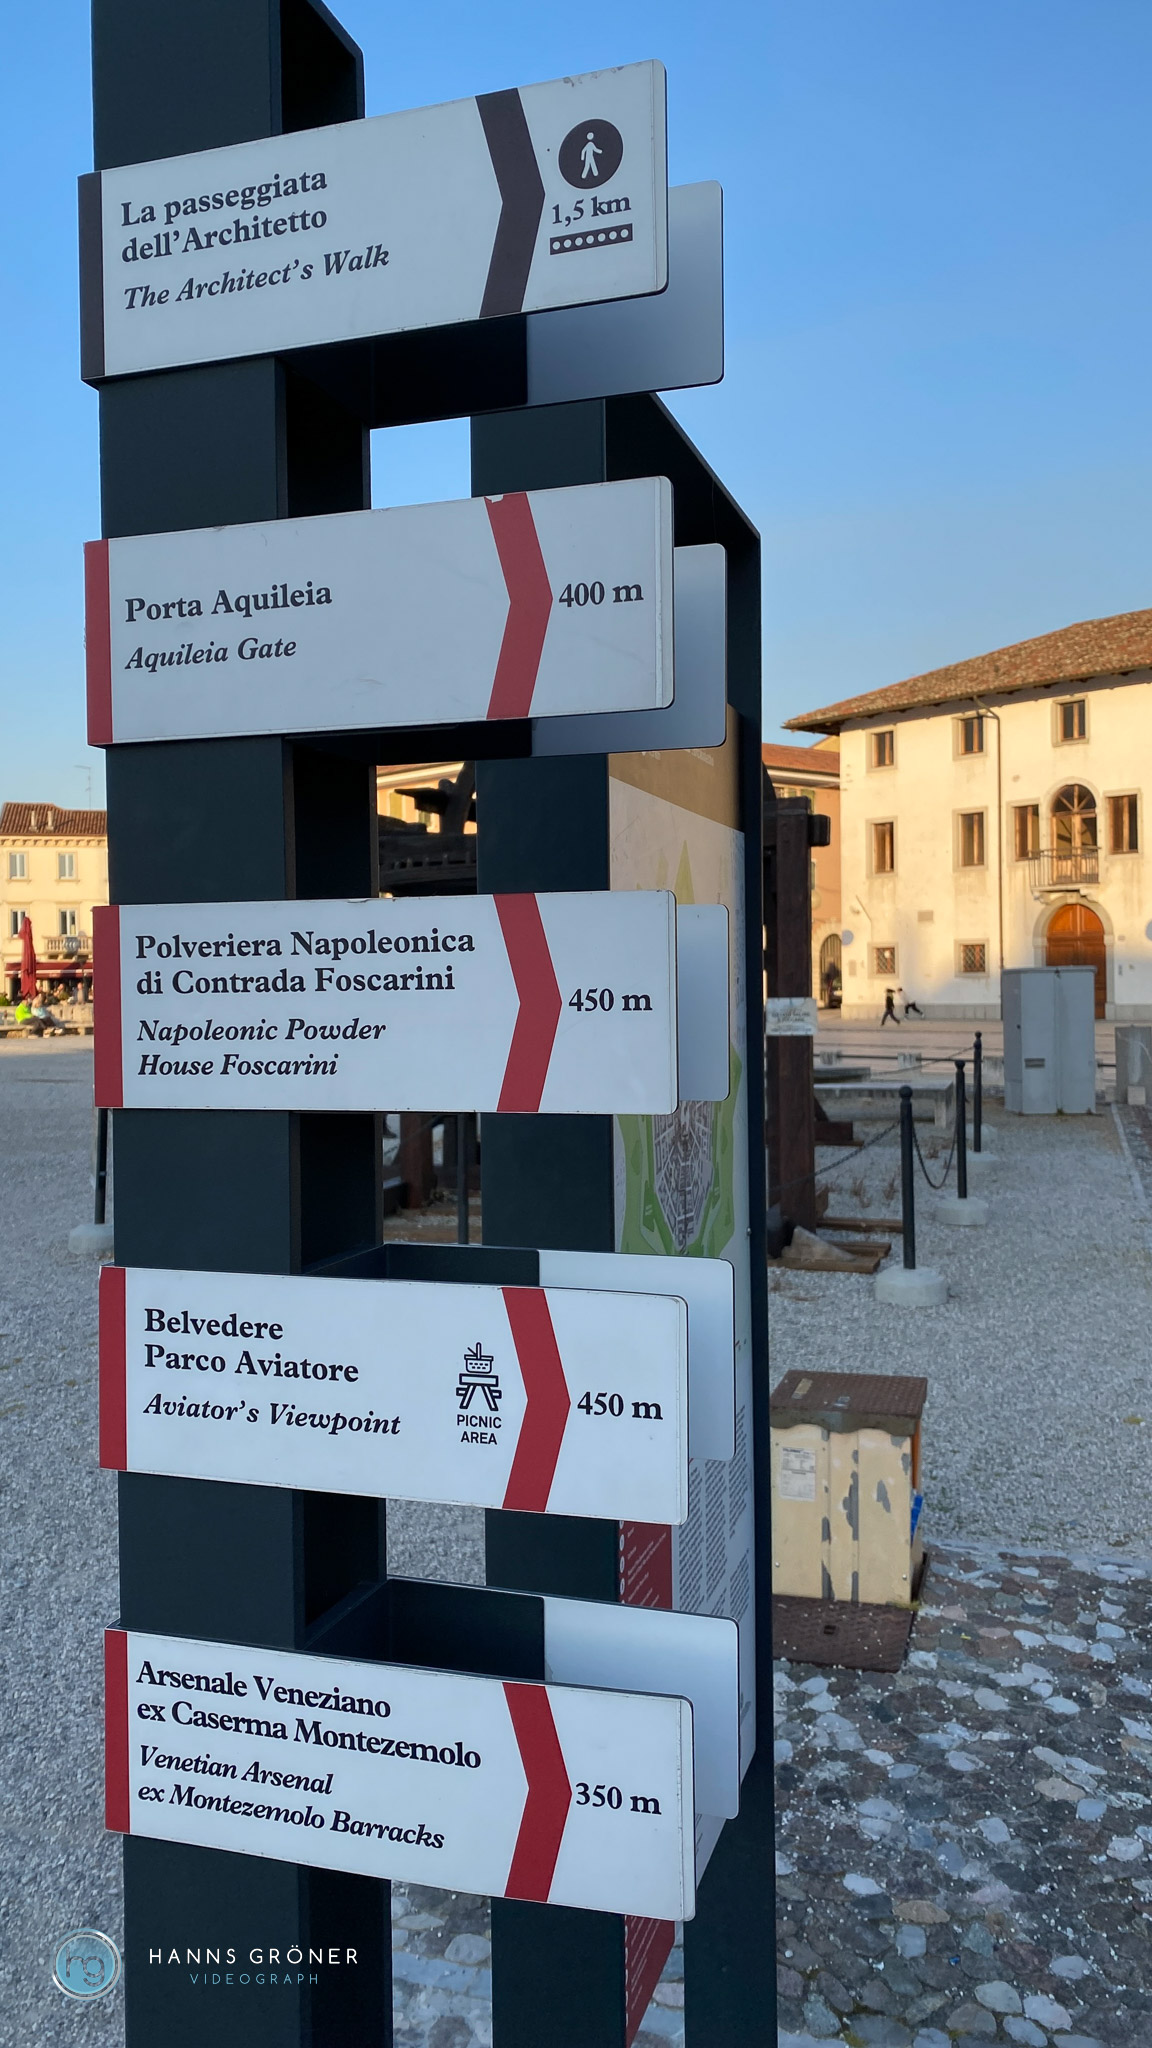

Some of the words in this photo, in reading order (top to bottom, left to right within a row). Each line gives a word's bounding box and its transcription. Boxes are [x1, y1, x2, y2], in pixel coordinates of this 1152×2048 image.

[120, 201, 157, 227] La
[163, 171, 328, 226] passeggiata
[552, 198, 585, 228] 1,5
[590, 195, 632, 218] km
[121, 209, 328, 263] dell’Architetto
[122, 284, 170, 310] The
[174, 258, 314, 302] Architect’s
[323, 243, 390, 276] Walk
[124, 597, 204, 623] Porta
[210, 580, 333, 618] Aquileia
[558, 580, 606, 608] 400
[612, 583, 645, 604] m
[124, 640, 229, 673] Aquileia
[237, 637, 297, 661] Gate
[135, 932, 283, 959] Polveriera
[290, 927, 476, 961] Napoleonica
[136, 970, 164, 995] di
[172, 967, 307, 995] Contrada
[314, 964, 456, 992] Foscarini
[568, 987, 615, 1012] 450
[621, 994, 653, 1012] m
[136, 1018, 278, 1047] Napoleonic
[284, 1017, 387, 1040] Powder
[137, 1054, 214, 1076] House
[219, 1053, 339, 1076] Foscarini
[144, 1308, 284, 1340] Belvedere
[144, 1343, 226, 1373] Parco
[234, 1350, 359, 1383] Aviatore
[142, 1393, 260, 1423] Aviator’s
[269, 1402, 401, 1436] Viewpoint
[456, 1413, 502, 1429] PICNIC
[577, 1391, 624, 1417] 450
[631, 1401, 664, 1421] m
[460, 1430, 498, 1446] AREA
[135, 1660, 248, 1698] Arsenale
[252, 1675, 391, 1718] Veneziano
[137, 1703, 166, 1723] ex
[171, 1700, 289, 1740] Caserma
[293, 1717, 482, 1769] Montezemolo
[140, 1744, 238, 1780] Venetian
[240, 1761, 334, 1795] Arsenal
[137, 1786, 165, 1803] ex
[168, 1783, 325, 1829] Montezemolo
[329, 1809, 445, 1849] Barracks
[575, 1782, 623, 1810] 350
[629, 1795, 662, 1816] m
